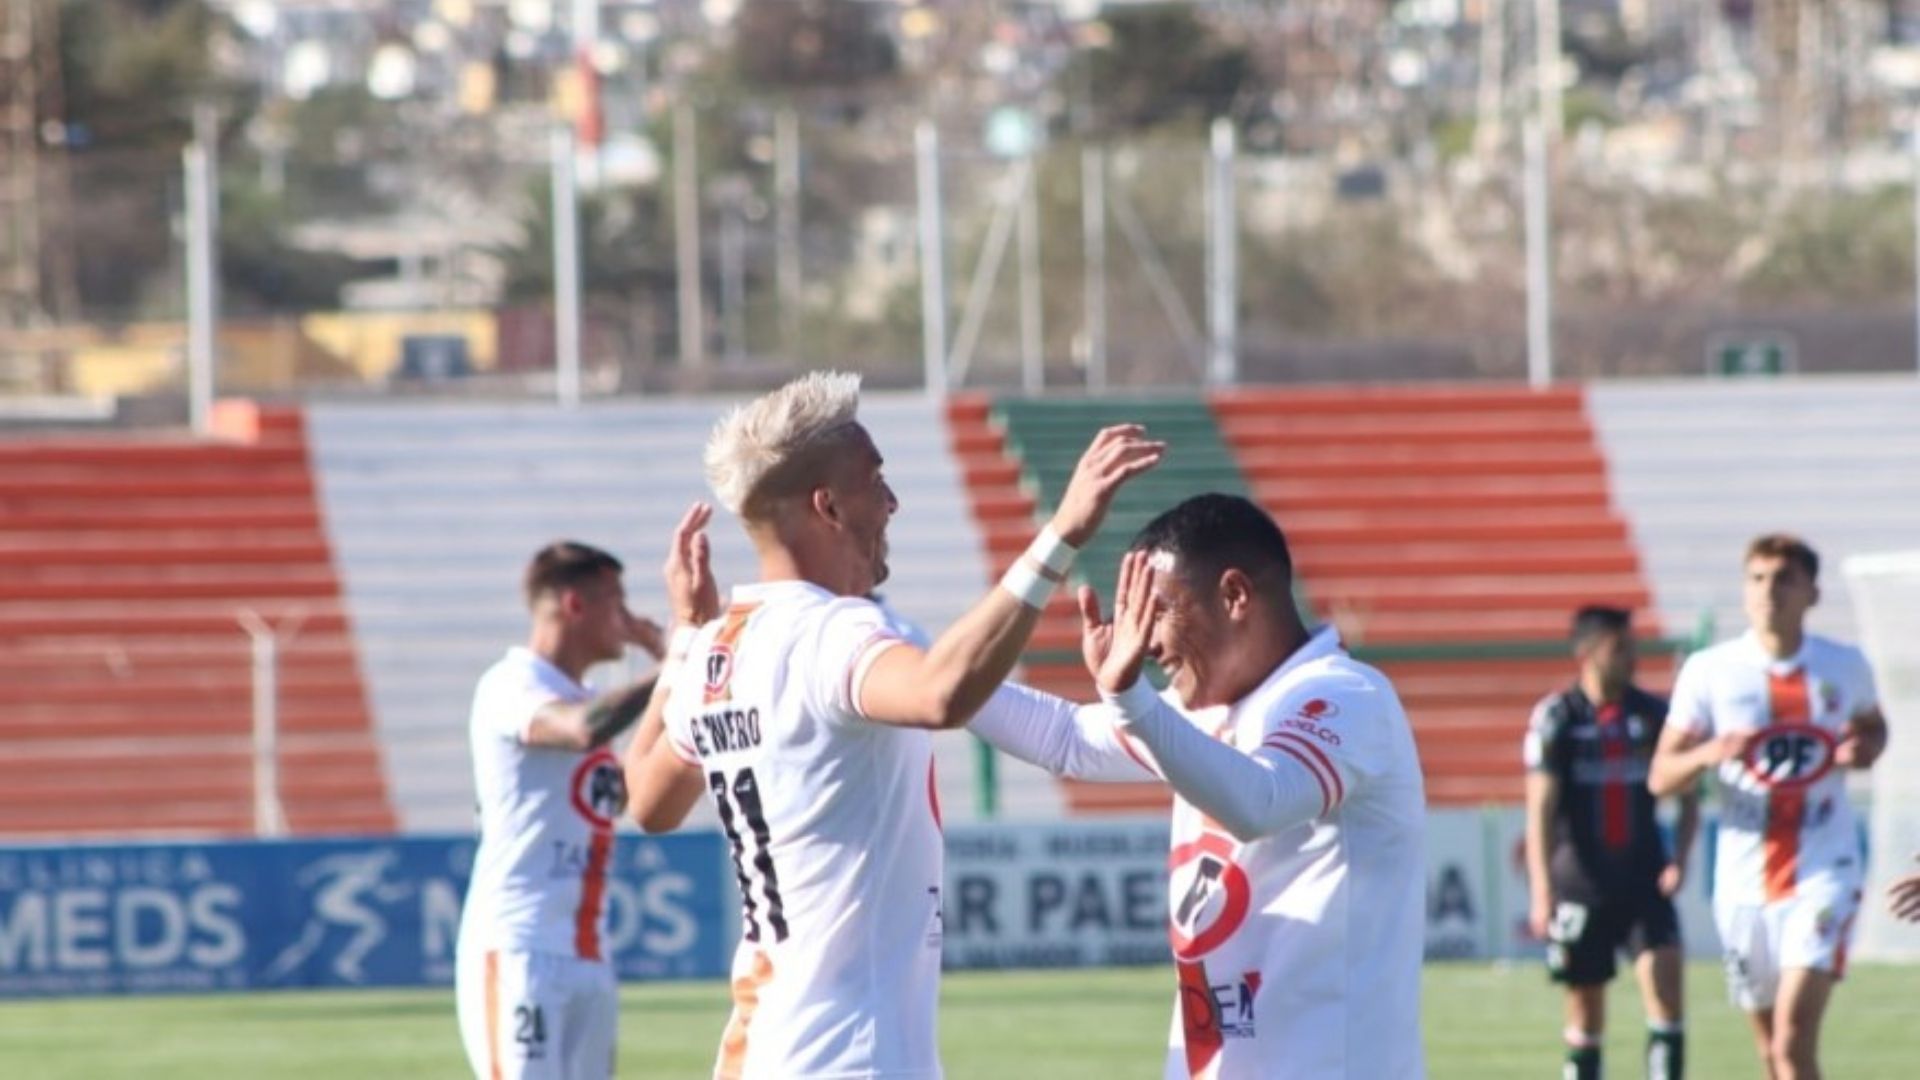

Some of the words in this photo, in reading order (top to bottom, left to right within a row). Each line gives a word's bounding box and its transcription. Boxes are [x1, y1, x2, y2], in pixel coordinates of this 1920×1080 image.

[1765, 733, 1819, 778] PF
[0, 882, 244, 968] MEDS
[420, 873, 697, 958] MDS
[1030, 868, 1167, 932] PAE
